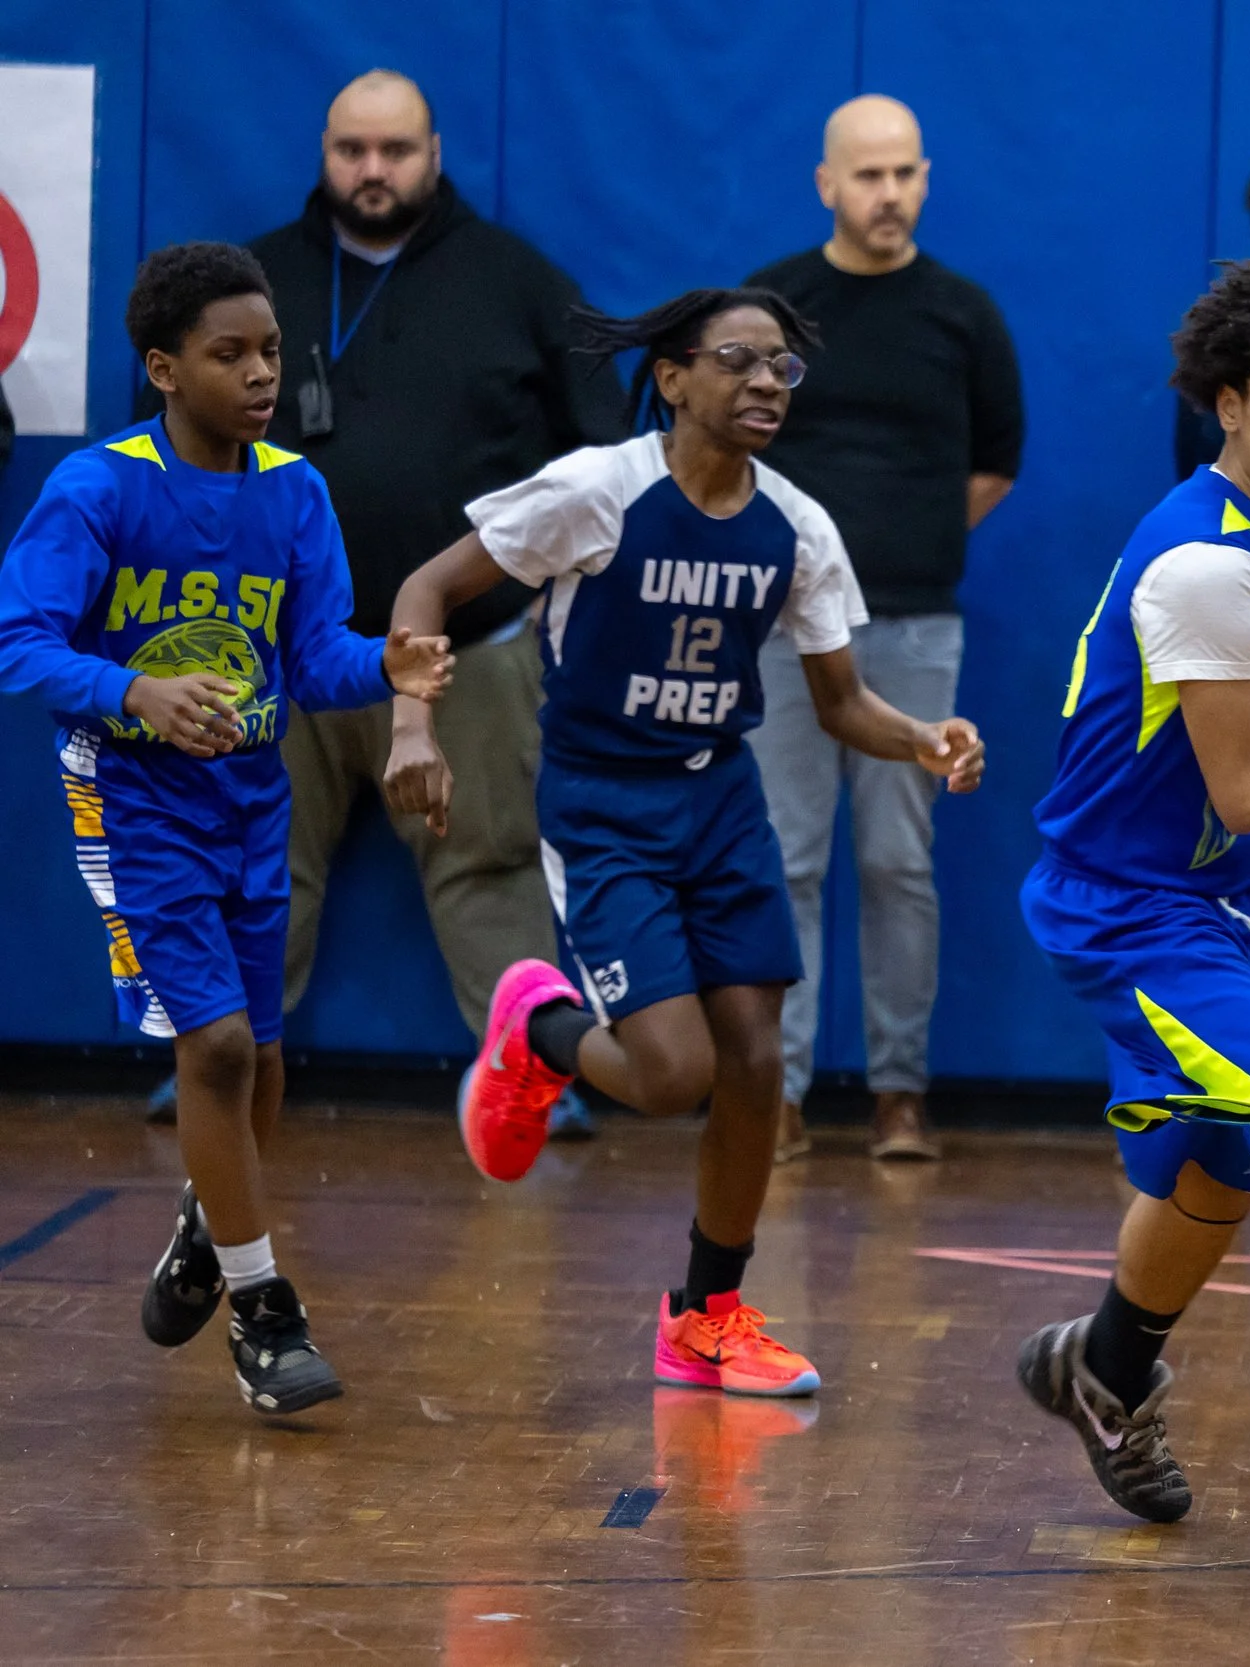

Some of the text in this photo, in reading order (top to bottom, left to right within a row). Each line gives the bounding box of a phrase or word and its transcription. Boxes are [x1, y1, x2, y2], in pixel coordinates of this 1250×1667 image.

[105, 566, 230, 631] M.S.
[640, 558, 778, 610] UNITY
[664, 614, 723, 673] 12
[623, 673, 740, 724] PREP
